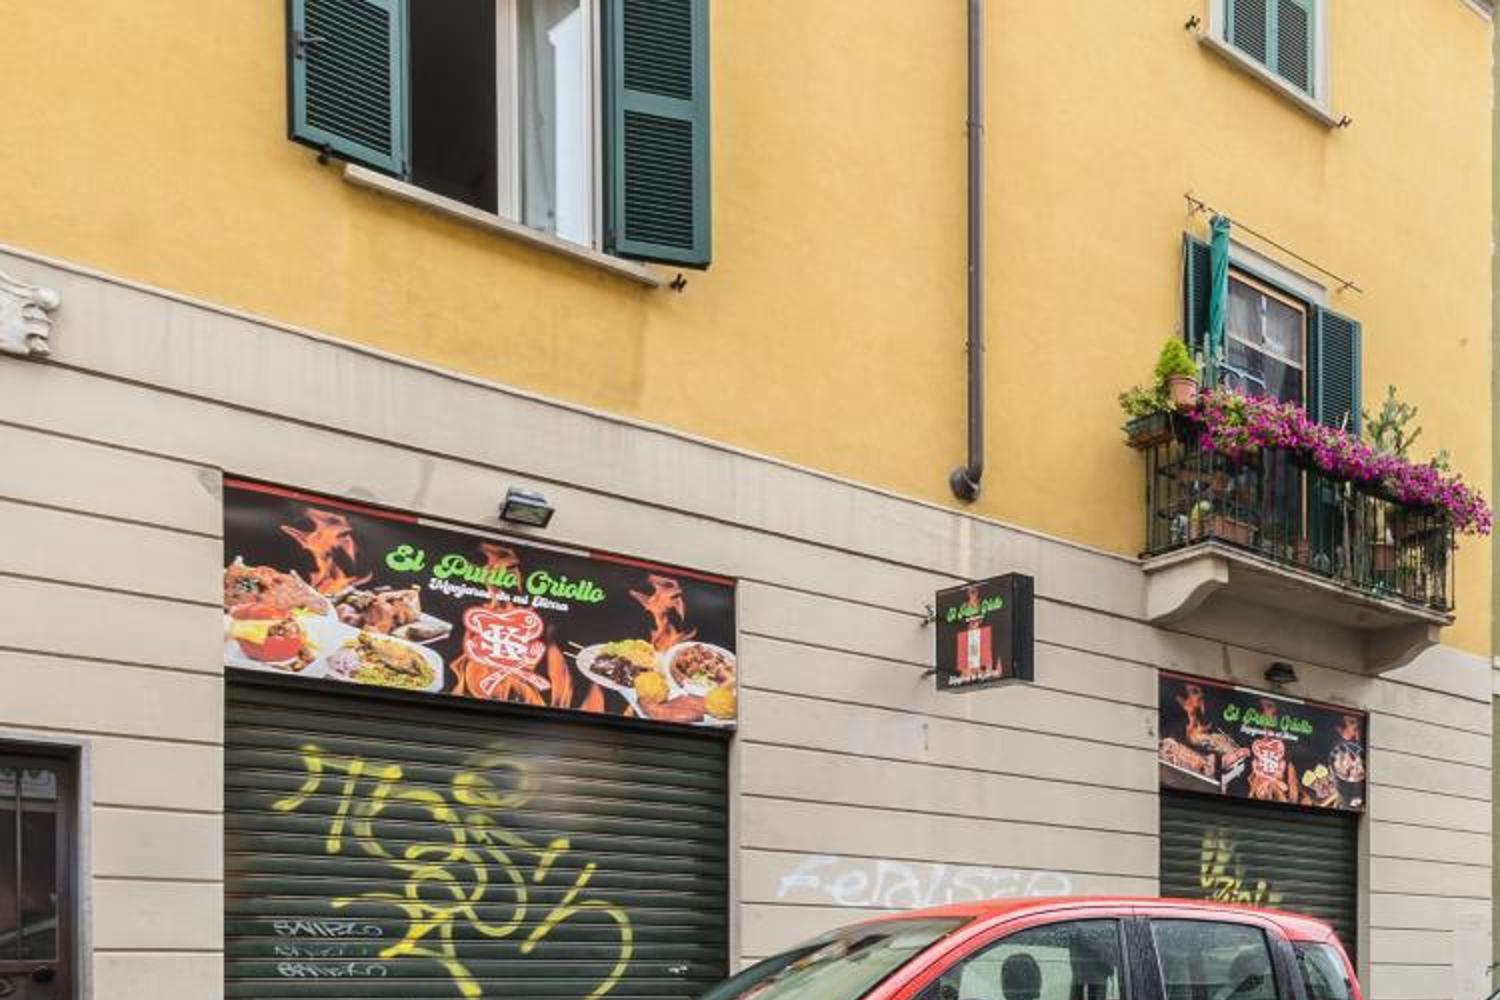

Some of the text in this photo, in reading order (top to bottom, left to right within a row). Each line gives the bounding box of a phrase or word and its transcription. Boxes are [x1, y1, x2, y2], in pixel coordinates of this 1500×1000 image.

[385, 544, 608, 603] El Punto Criollo
